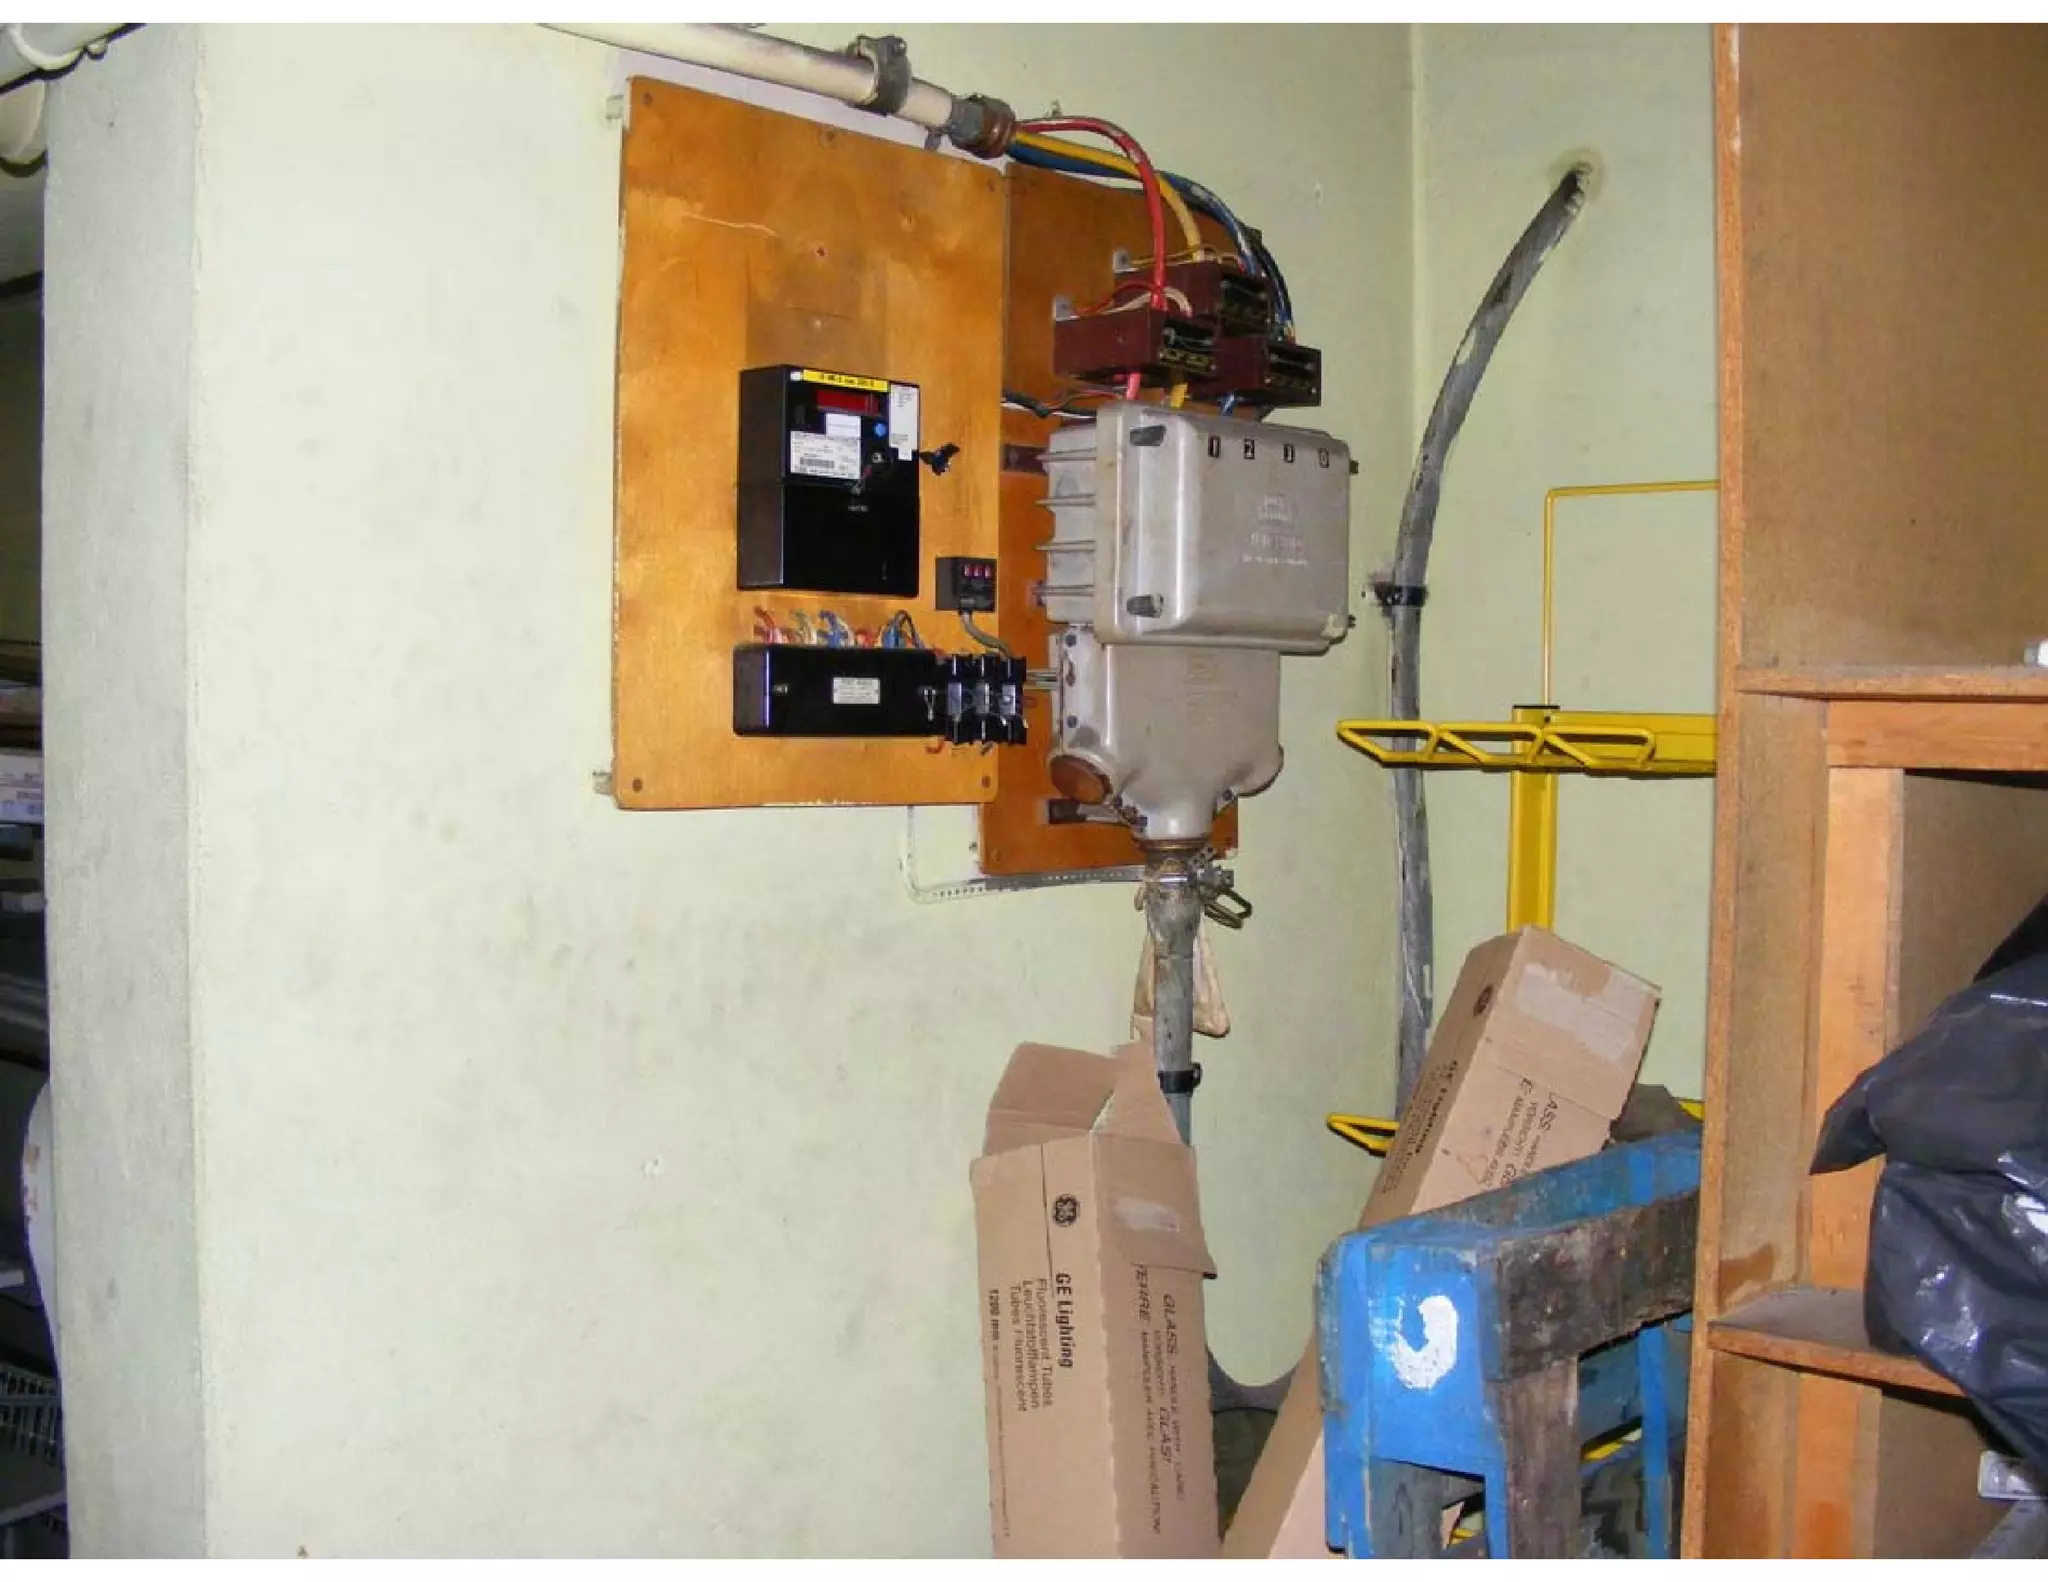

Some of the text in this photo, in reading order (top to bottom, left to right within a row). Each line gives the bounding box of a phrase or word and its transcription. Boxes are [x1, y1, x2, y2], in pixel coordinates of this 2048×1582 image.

[1009, 1285, 1028, 1412] Tubes Fluorescent
[1022, 1280, 1040, 1410] Leuchtstofflampen
[1037, 1278, 1054, 1407] Fluorescent Tubes
[1055, 1272, 1075, 1368] GE Lighting
